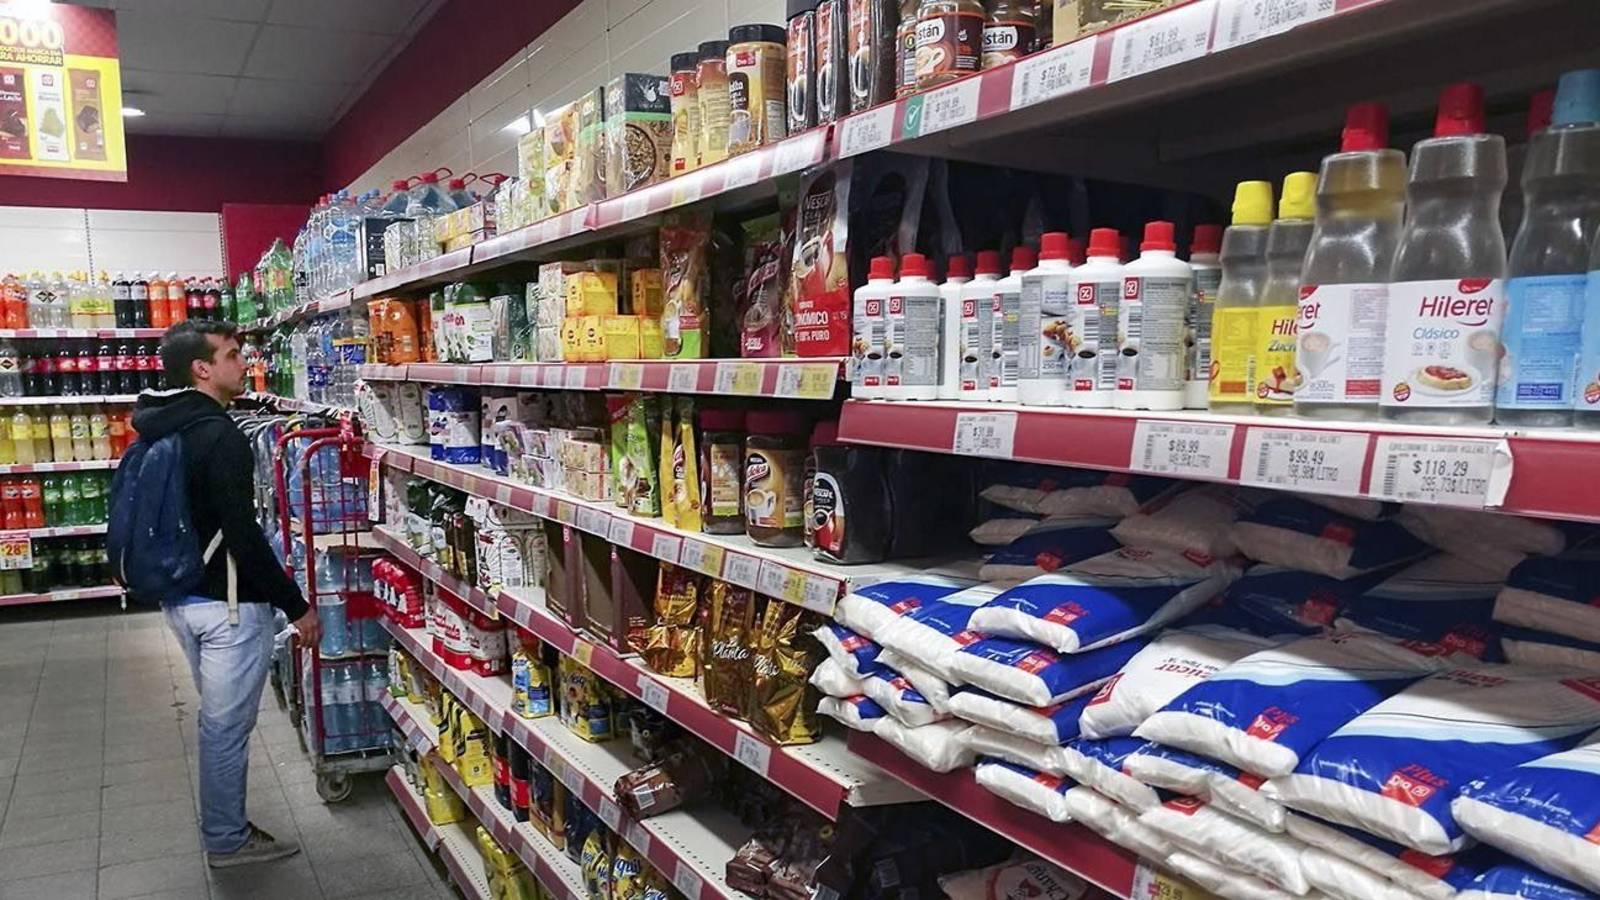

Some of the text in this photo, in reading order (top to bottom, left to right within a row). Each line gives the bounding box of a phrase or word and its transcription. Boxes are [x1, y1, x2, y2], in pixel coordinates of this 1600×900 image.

[918, 25, 940, 40] stán
[1419, 295, 1494, 319] Hileret
[1412, 327, 1460, 340] Clásico
[1289, 449, 1325, 465] $99.49
[1412, 459, 1468, 477] $118.29
